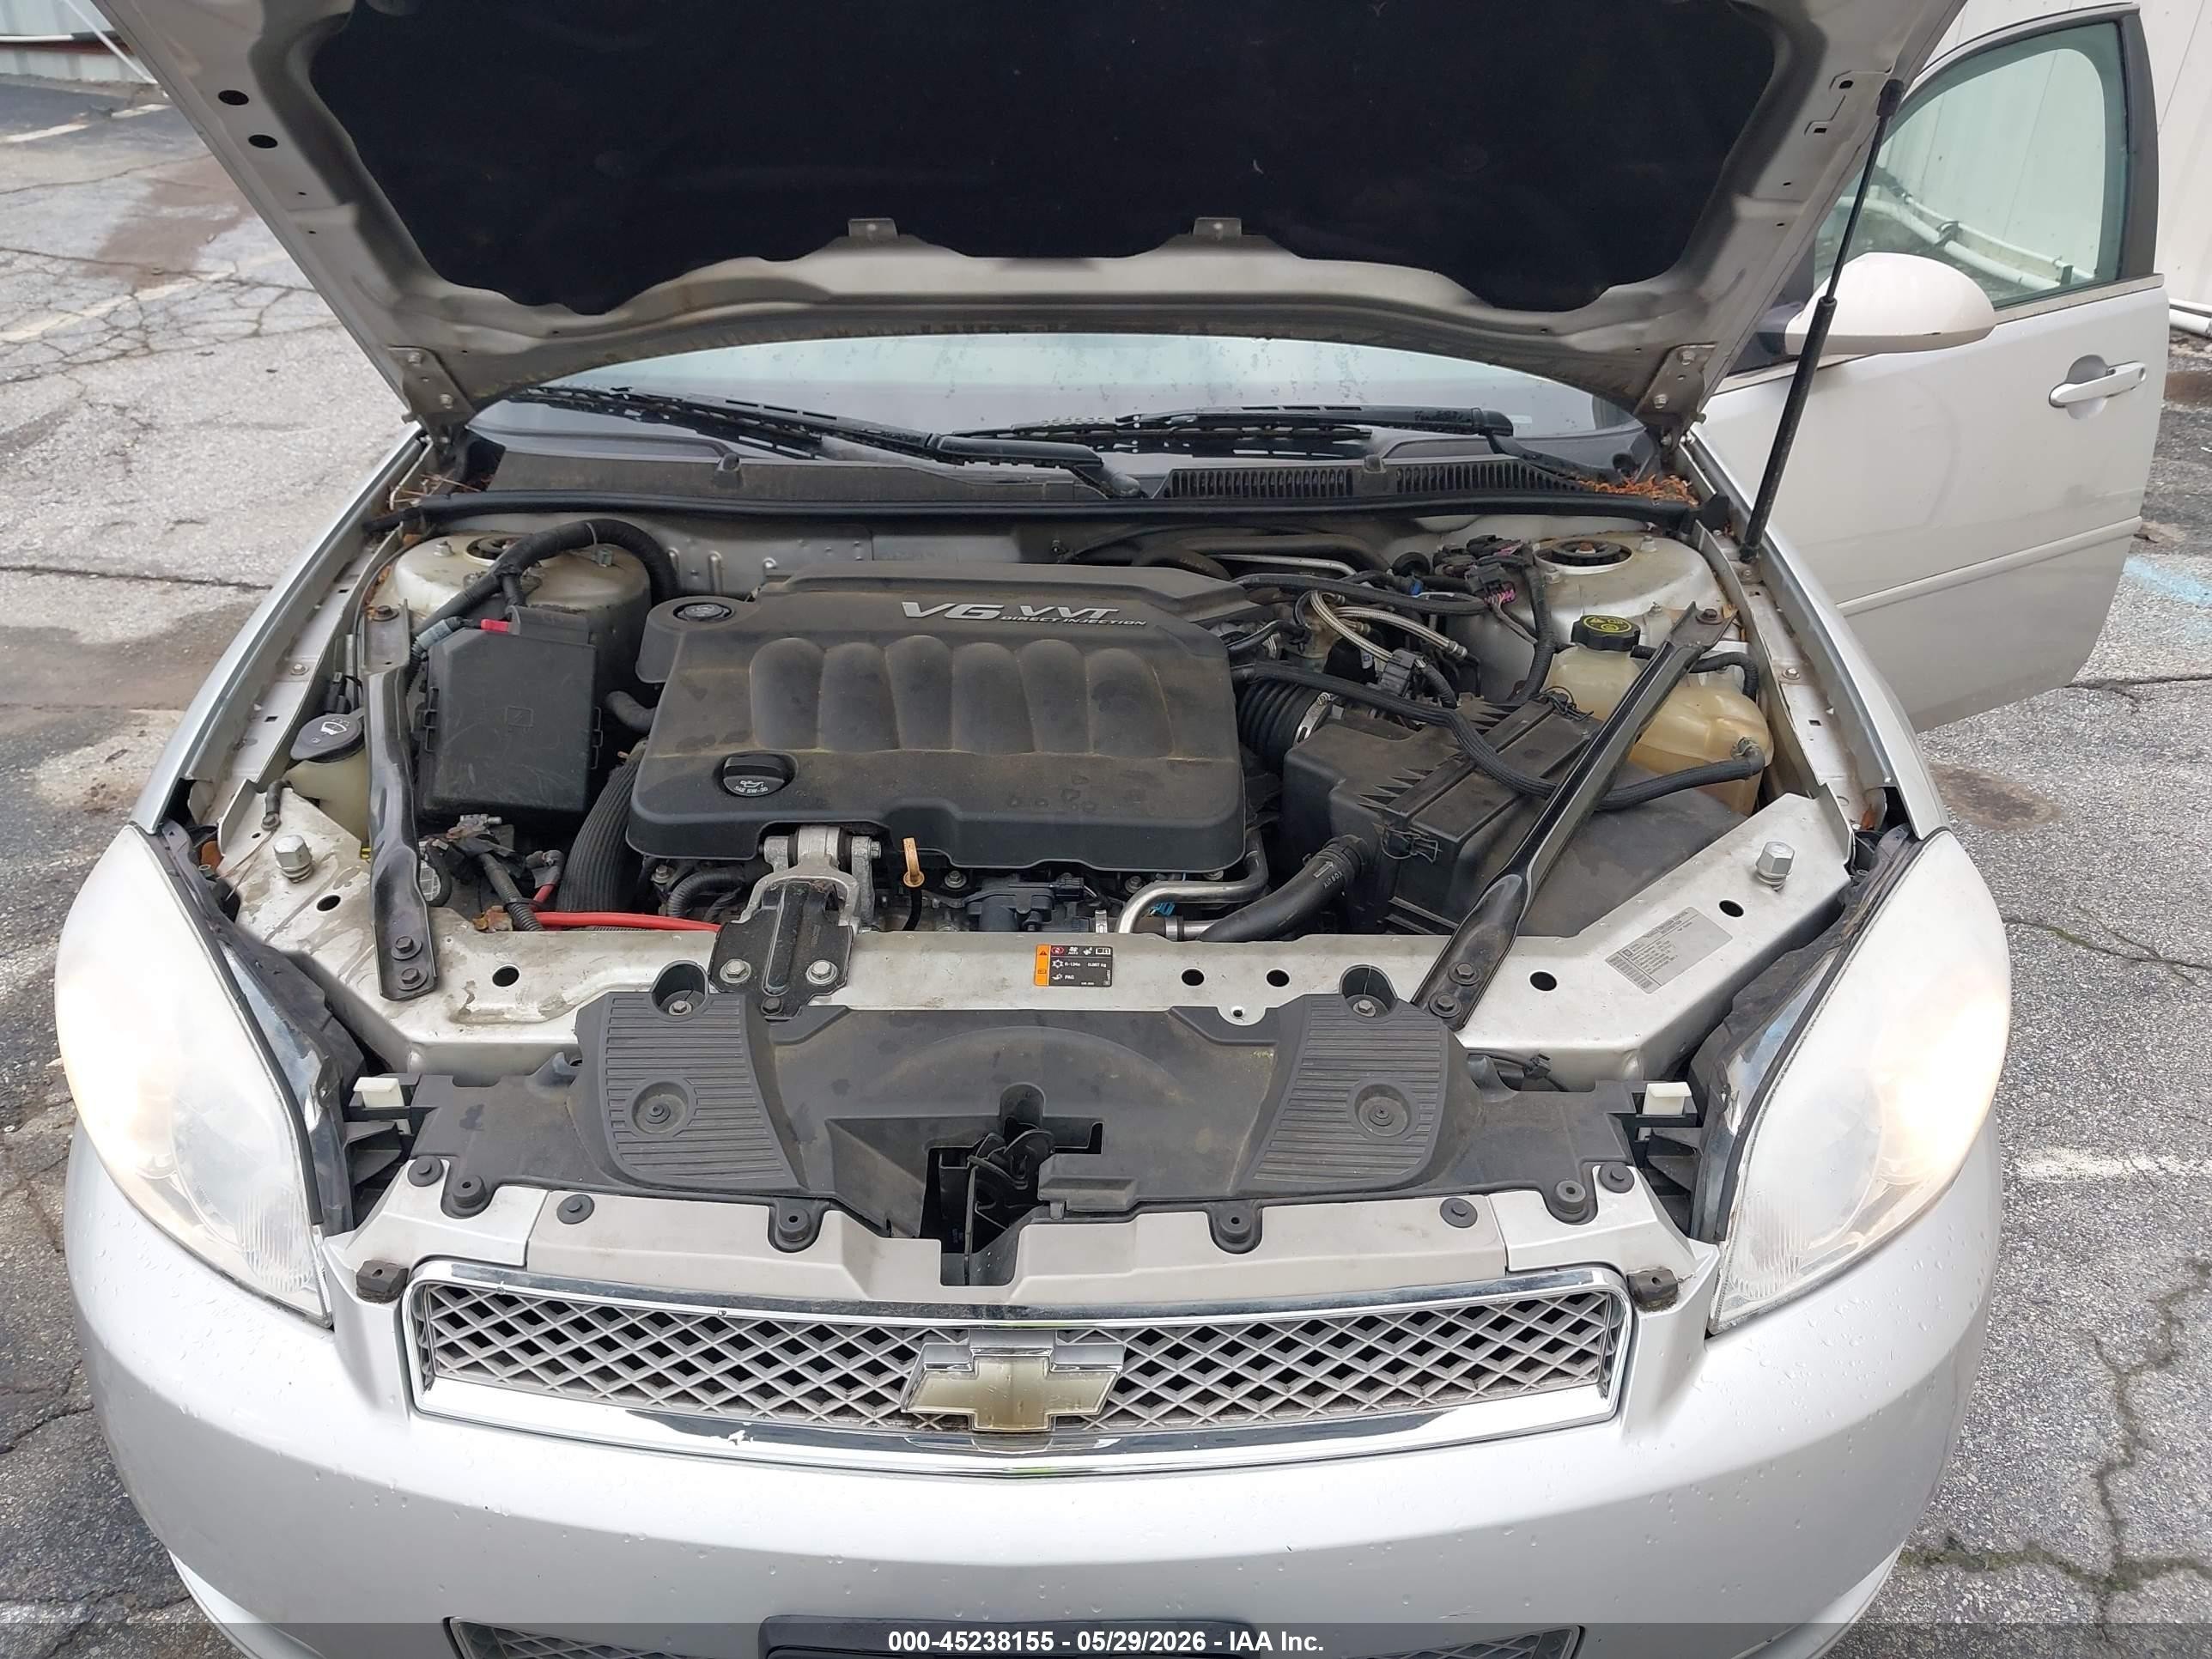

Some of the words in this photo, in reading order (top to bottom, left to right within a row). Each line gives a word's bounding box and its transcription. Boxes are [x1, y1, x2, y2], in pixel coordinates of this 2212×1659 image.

[902, 601, 1004, 620] V6
[1019, 605, 1120, 619] VVT
[1062, 617, 1147, 627] INJECTION
